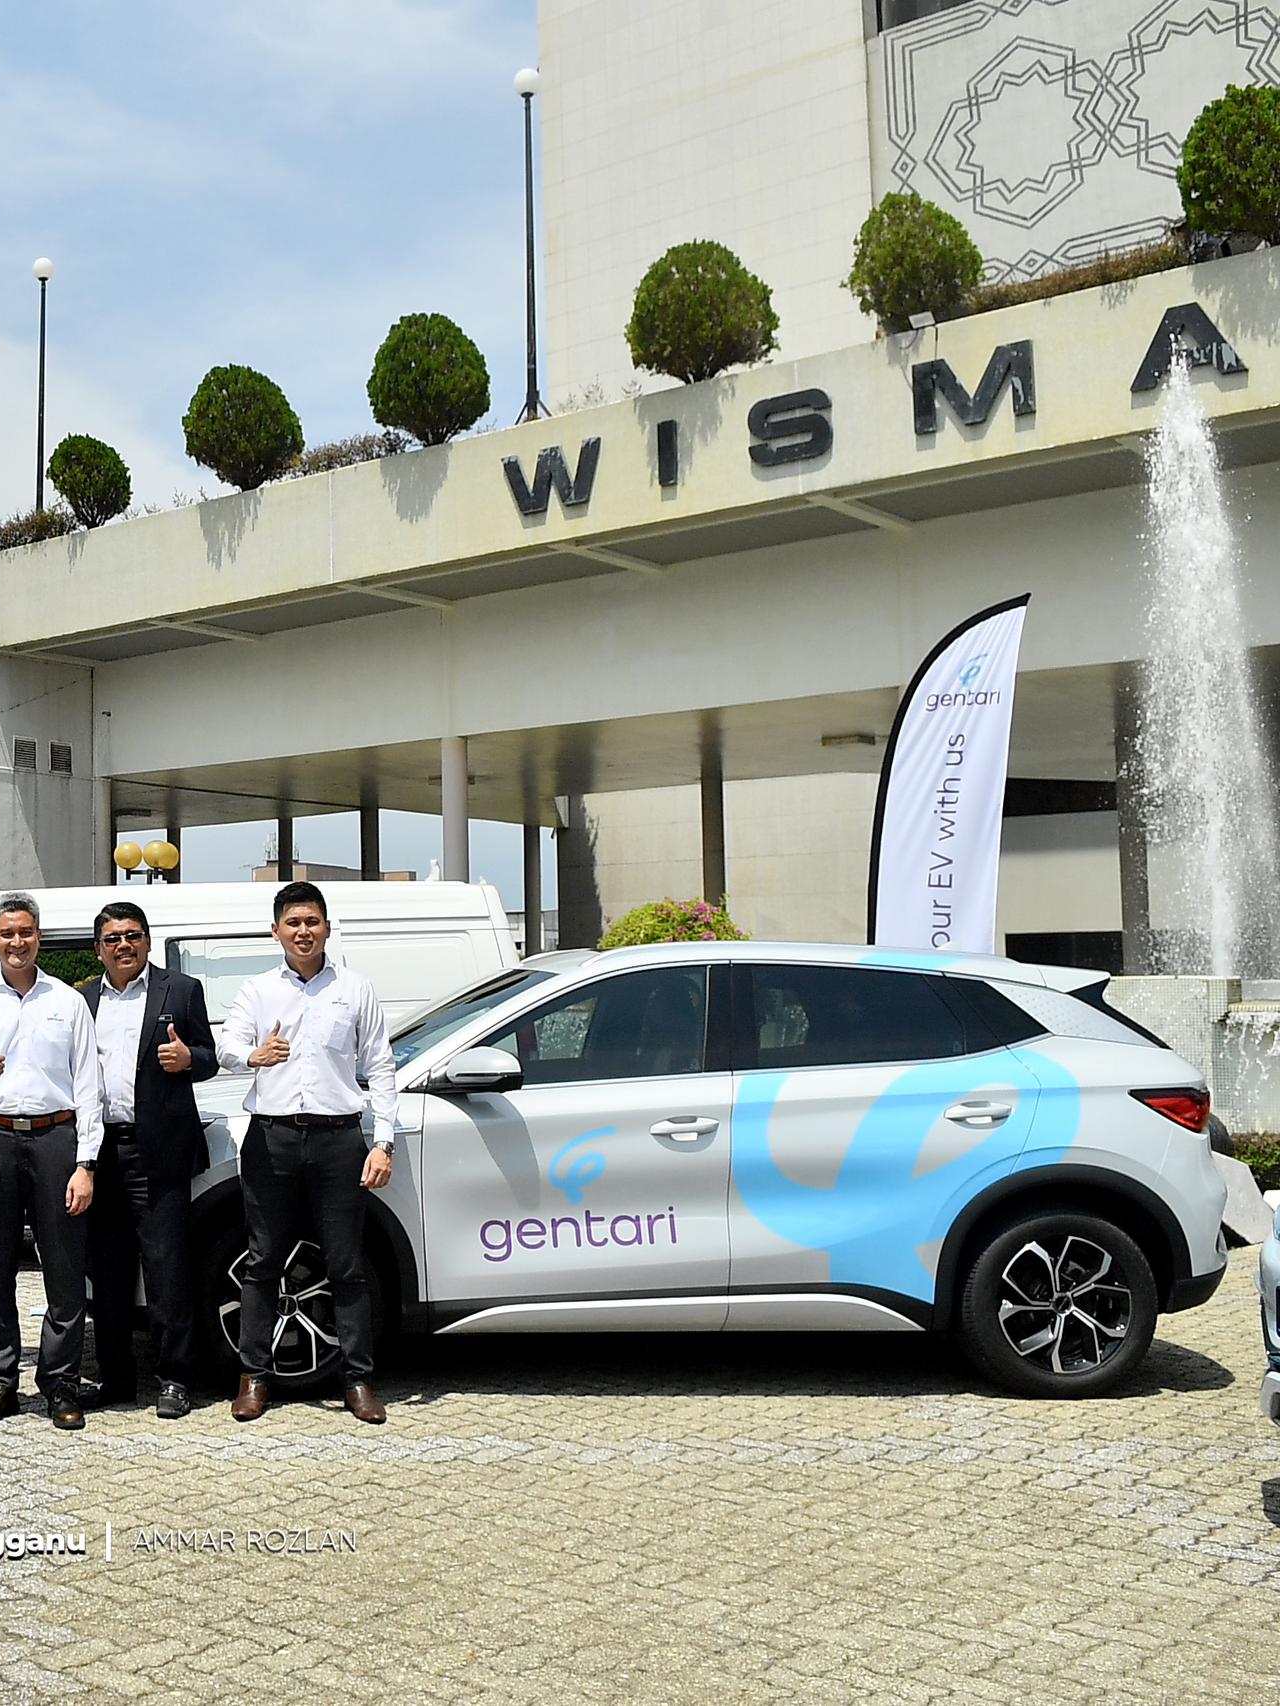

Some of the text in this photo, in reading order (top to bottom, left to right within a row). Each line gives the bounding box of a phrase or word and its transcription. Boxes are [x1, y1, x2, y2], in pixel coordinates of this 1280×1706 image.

[500, 302, 1249, 515] WISMA
[925, 690, 1000, 712] gentari
[945, 733, 965, 766] us
[933, 777, 962, 841] with
[927, 851, 954, 889] EV
[479, 1206, 677, 1262] gentari
